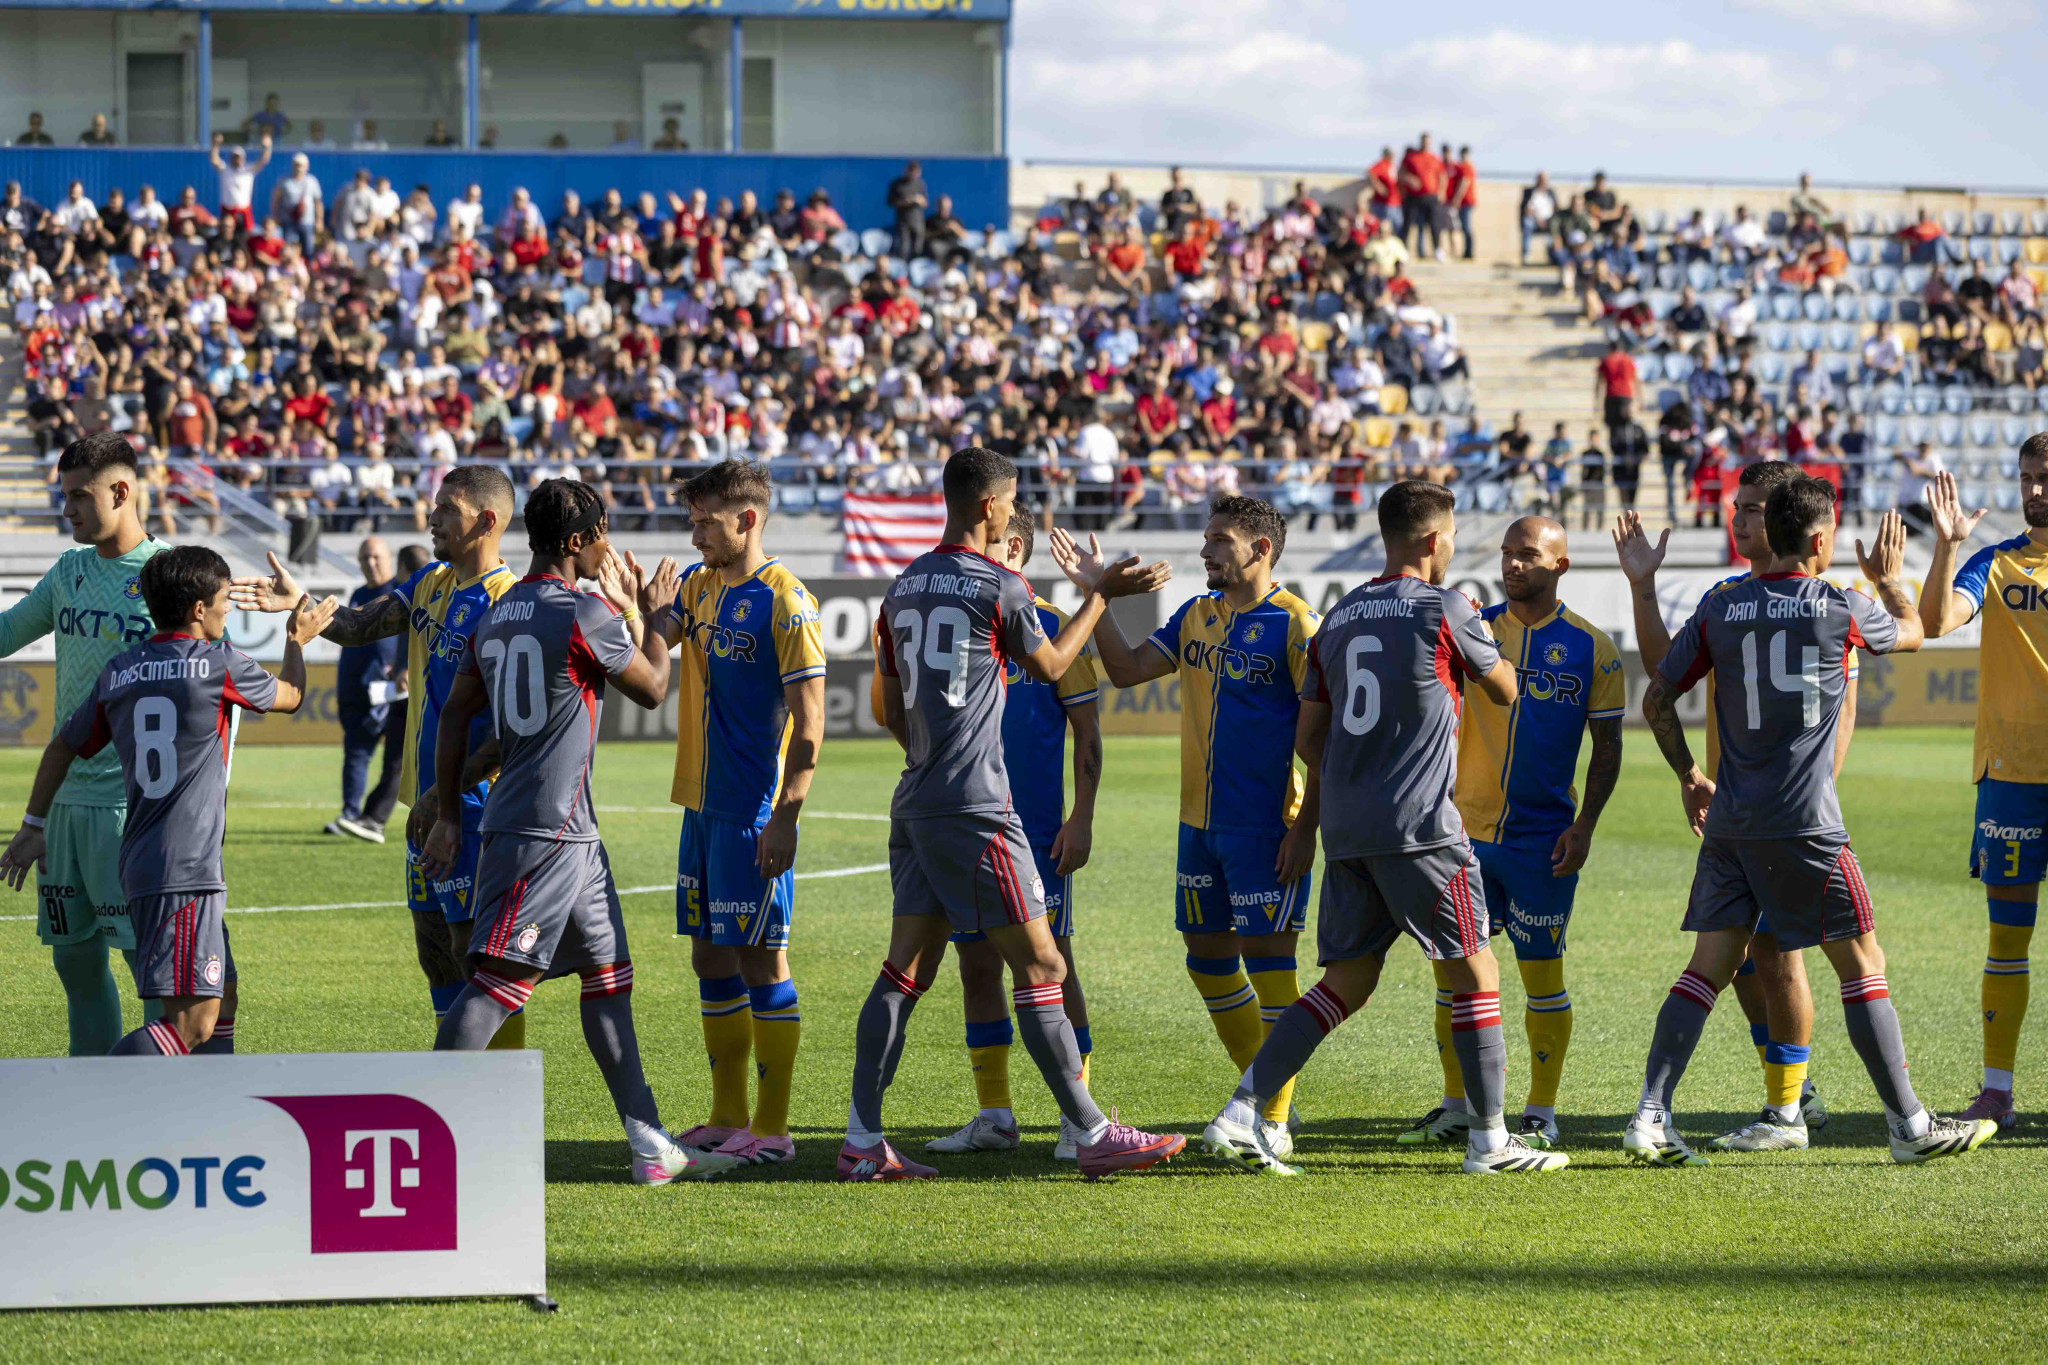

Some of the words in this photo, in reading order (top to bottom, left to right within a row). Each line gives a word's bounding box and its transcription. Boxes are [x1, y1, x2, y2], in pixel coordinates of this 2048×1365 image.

[929, 573, 982, 599] MANCHA
[1724, 600, 1758, 621] DANI
[1767, 598, 1828, 618] GARCIA
[110, 658, 210, 691] D.NASCIMENTO
[894, 606, 971, 710] 39
[481, 635, 548, 740] 70
[1343, 635, 1383, 735] 6
[1515, 666, 1583, 706] TOR
[1742, 630, 1820, 730] 14
[134, 696, 178, 799] 8
[1981, 821, 2042, 840] avance
[2004, 840, 2021, 877] 3
[46, 897, 69, 936] 91
[686, 888, 700, 926] 5
[709, 898, 757, 914] adounas
[1184, 888, 1204, 925] 11
[1510, 898, 1565, 927] badounas
[1507, 920, 1532, 944] .com
[0, 1154, 267, 1213] SMOTE
[345, 1129, 419, 1217] T
